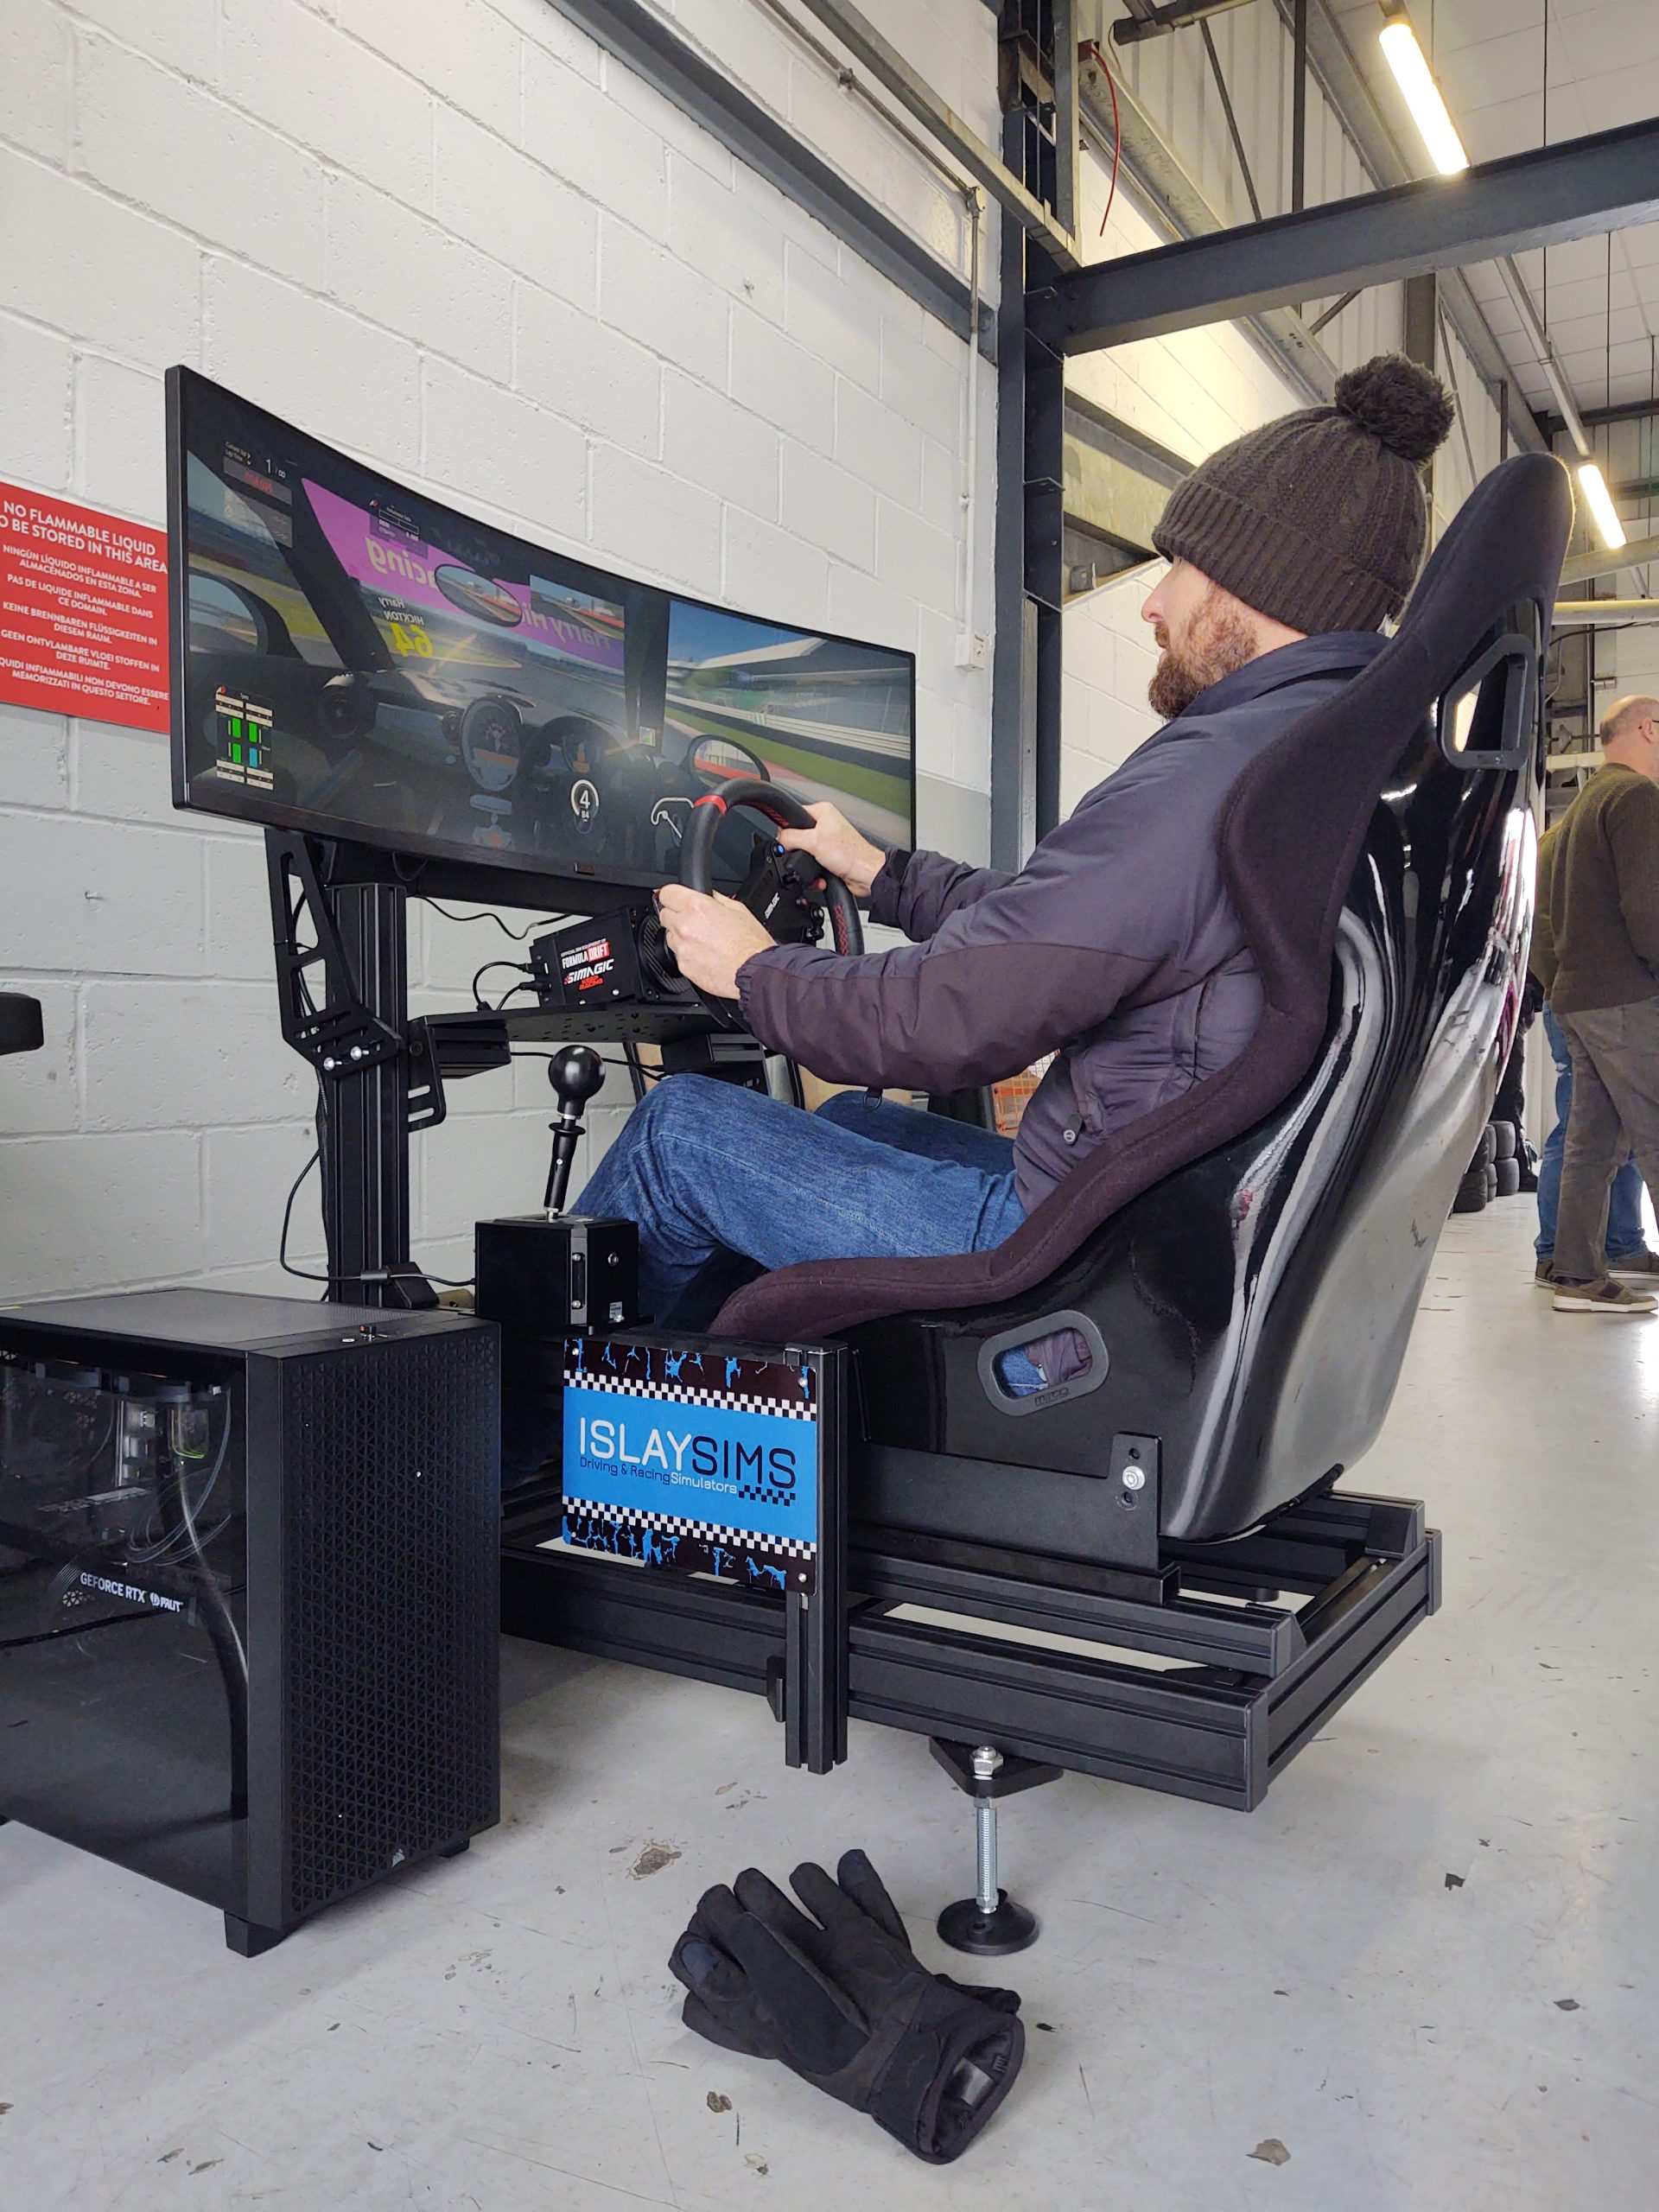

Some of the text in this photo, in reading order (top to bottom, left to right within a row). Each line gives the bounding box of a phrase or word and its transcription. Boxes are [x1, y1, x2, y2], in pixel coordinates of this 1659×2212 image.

[3, 499, 156, 556] NO FLAMMABLE LIQUID
[0, 515, 168, 575] O BE STORED IN THIS AREA
[3, 544, 39, 562] NINGÚN
[19, 558, 85, 582] ALMACENADOS
[98, 579, 117, 591] ESTA
[7, 573, 23, 585] PAS
[25, 578, 37, 588] DE
[38, 582, 73, 598] LIQUIDE
[131, 606, 154, 619] DANS
[58, 596, 70, 607] CE
[3, 601, 29, 614] KEINE
[30, 607, 88, 628] BRENNBAREN
[1, 629, 25, 641] GEEN
[54, 623, 85, 638] DIESEM
[0, 657, 24, 670] QUIDI
[580, 790, 590, 809] 4
[562, 942, 608, 969] FORMULA DRIFT
[567, 958, 614, 984] SIMAGIC
[580, 1417, 796, 1489] ISLAYSIMS
[580, 1456, 619, 1476] Driving
[621, 1464, 628, 1475] &
[80, 1572, 146, 1604] GEFORCE RTX
